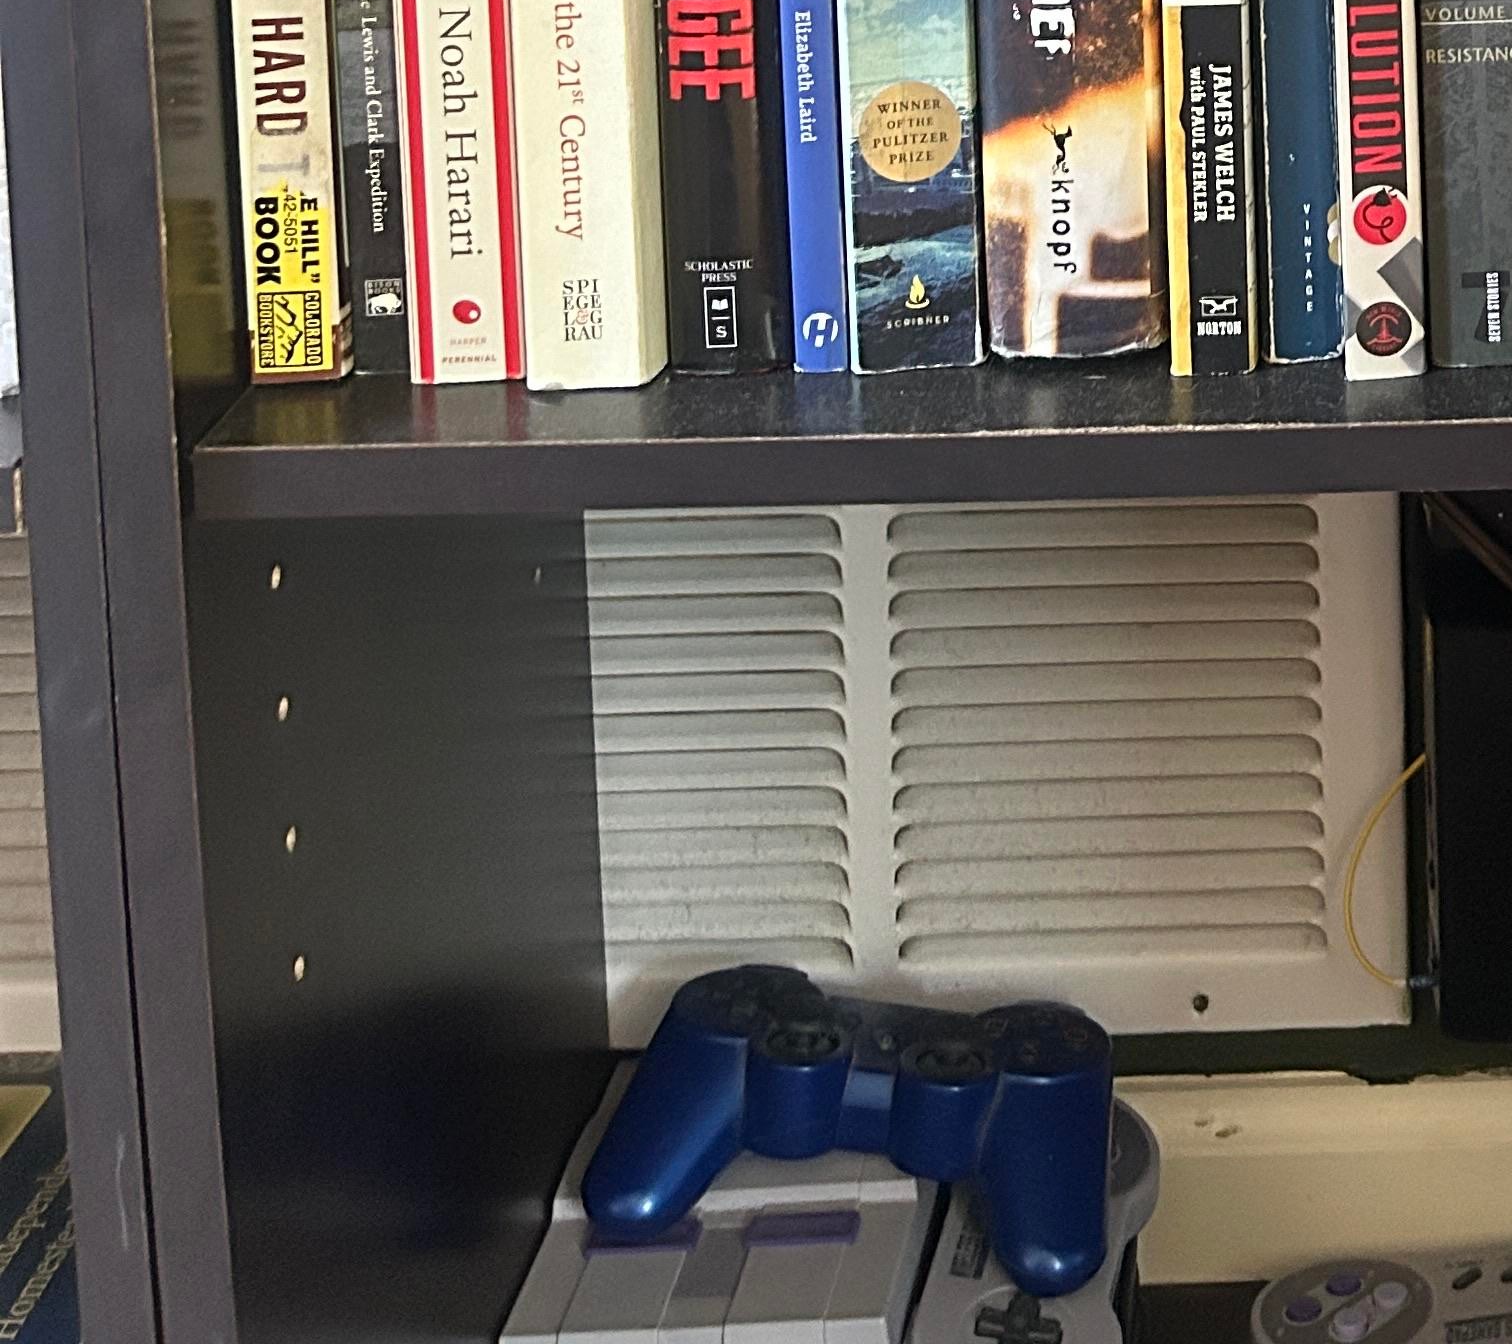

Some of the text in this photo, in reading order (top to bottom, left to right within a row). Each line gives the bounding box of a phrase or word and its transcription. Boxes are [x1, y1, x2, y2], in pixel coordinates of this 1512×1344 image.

[250, 17, 308, 137] HARD
[437, 7, 479, 116] Noah
[794, 11, 817, 142] Elizabeth Laird
[360, 17, 387, 232] Lewis and Clark Expedition
[1189, 66, 1208, 223] with PAUL STEKLER
[444, 129, 483, 258] Harari
[258, 293, 275, 366] BOOKSTORE
[304, 291, 322, 364] COLORADO
